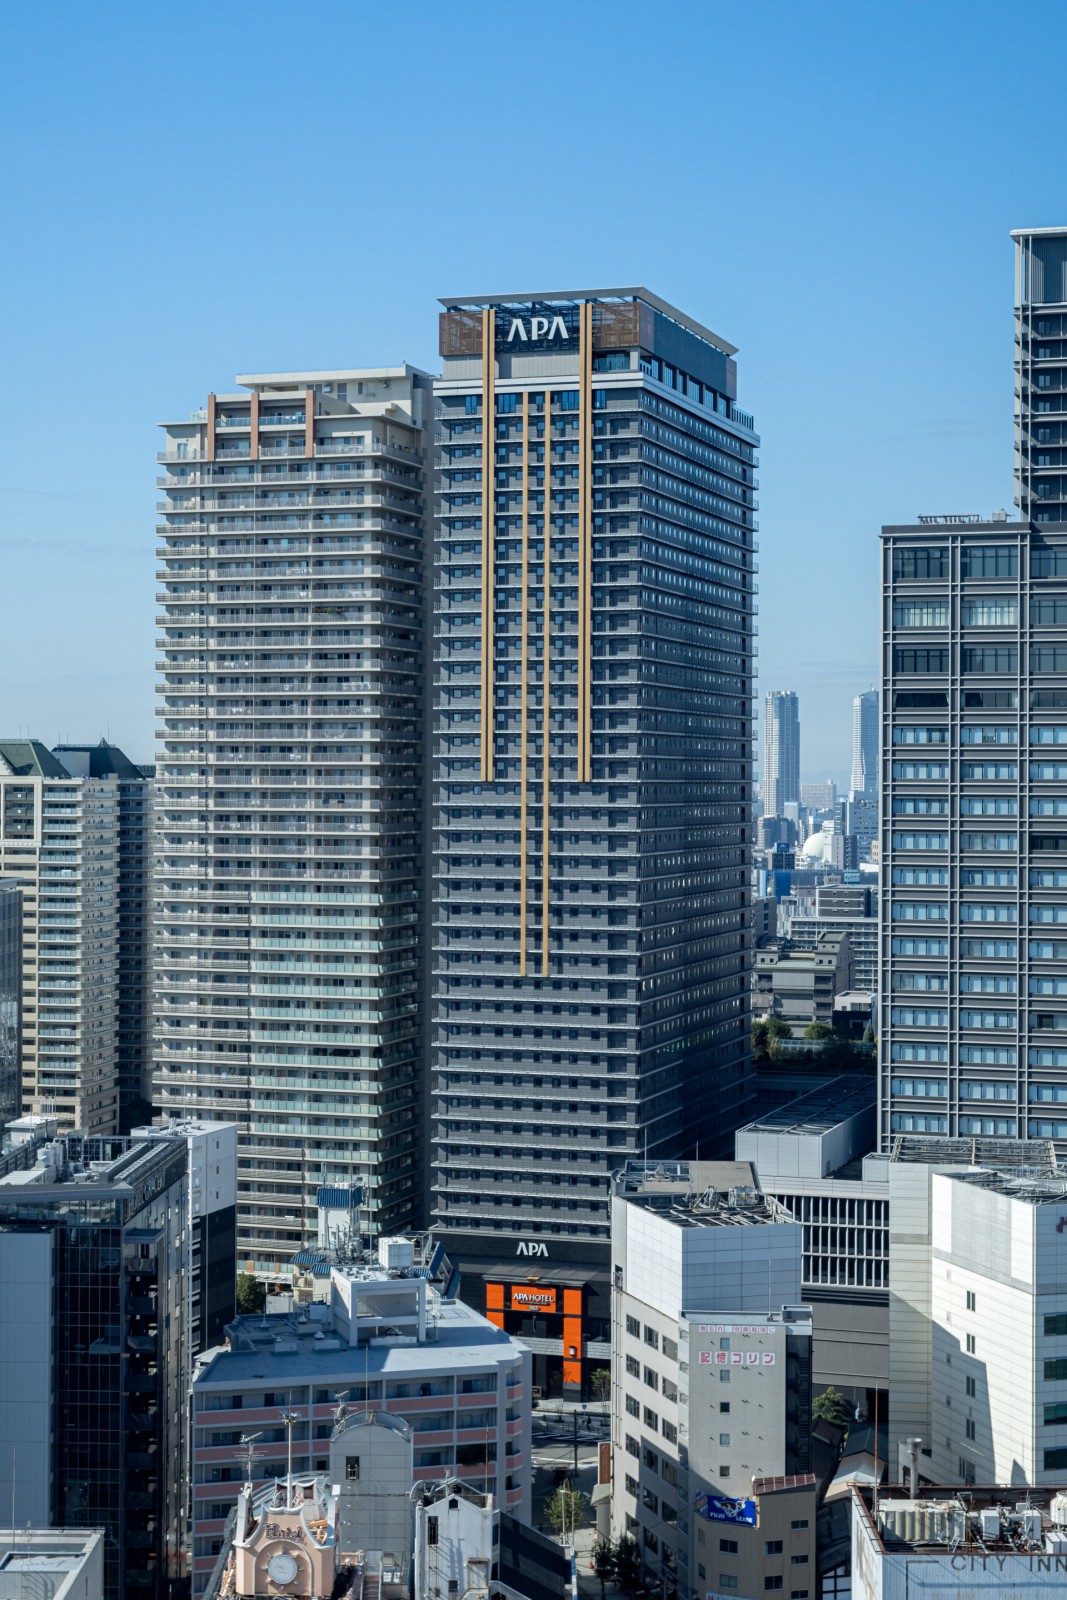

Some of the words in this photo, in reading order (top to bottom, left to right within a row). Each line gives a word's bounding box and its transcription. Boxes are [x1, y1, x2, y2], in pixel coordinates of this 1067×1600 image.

[507, 316, 570, 342] APA
[516, 1242, 549, 1257] APA
[513, 1292, 529, 1301] APA
[530, 1294, 554, 1303] HOTEL
[700, 1352, 774, 1365] 記憶コリン
[951, 1555, 1007, 1572] CITY
[1030, 1555, 1067, 1572] INN
